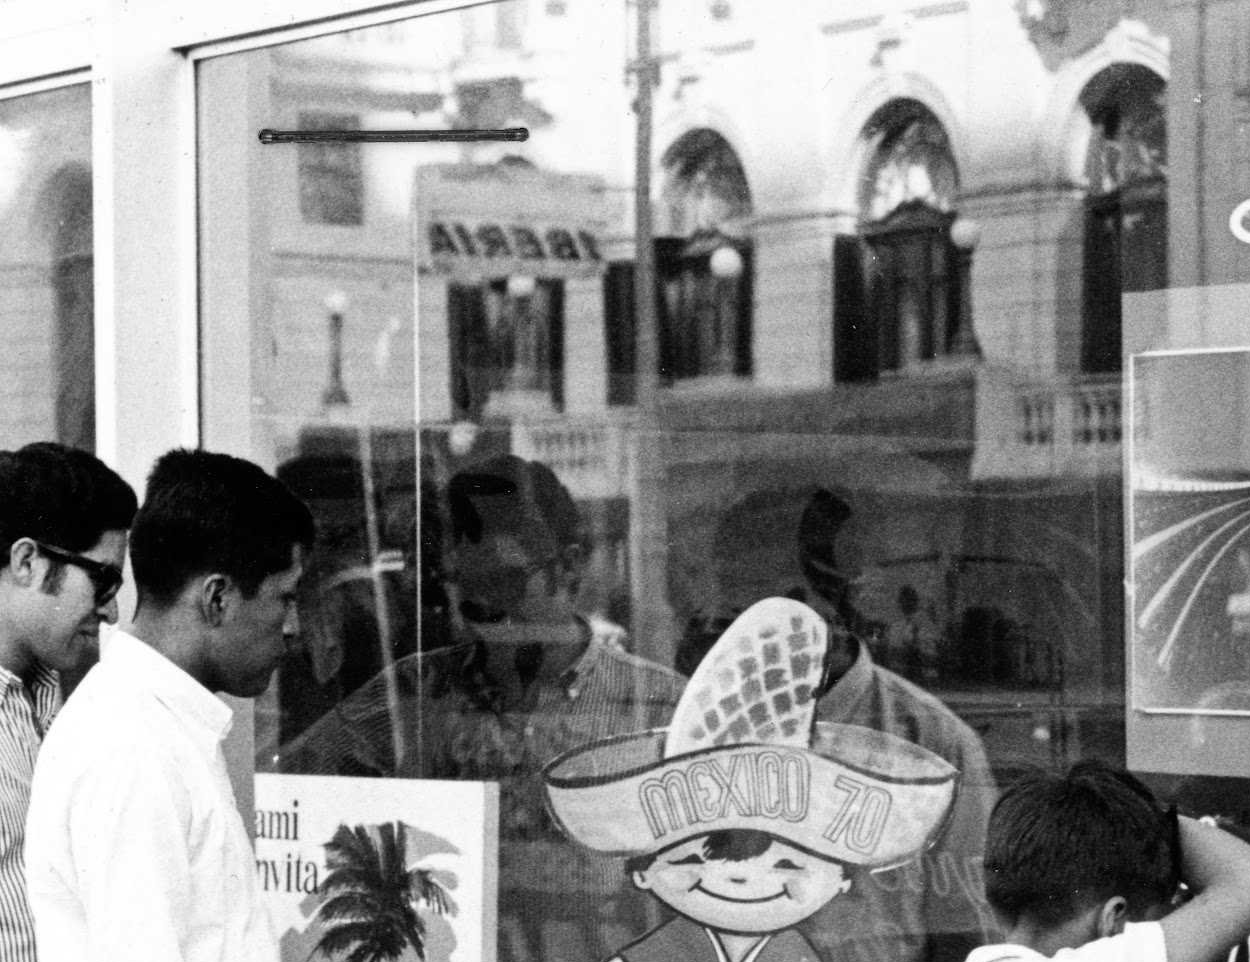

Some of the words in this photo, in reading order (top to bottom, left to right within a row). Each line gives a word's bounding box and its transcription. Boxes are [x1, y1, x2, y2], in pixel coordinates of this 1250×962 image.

[255, 799, 300, 841] ami
[639, 751, 812, 839] MEXICO
[822, 774, 892, 855] 70
[256, 852, 319, 895] nvita
